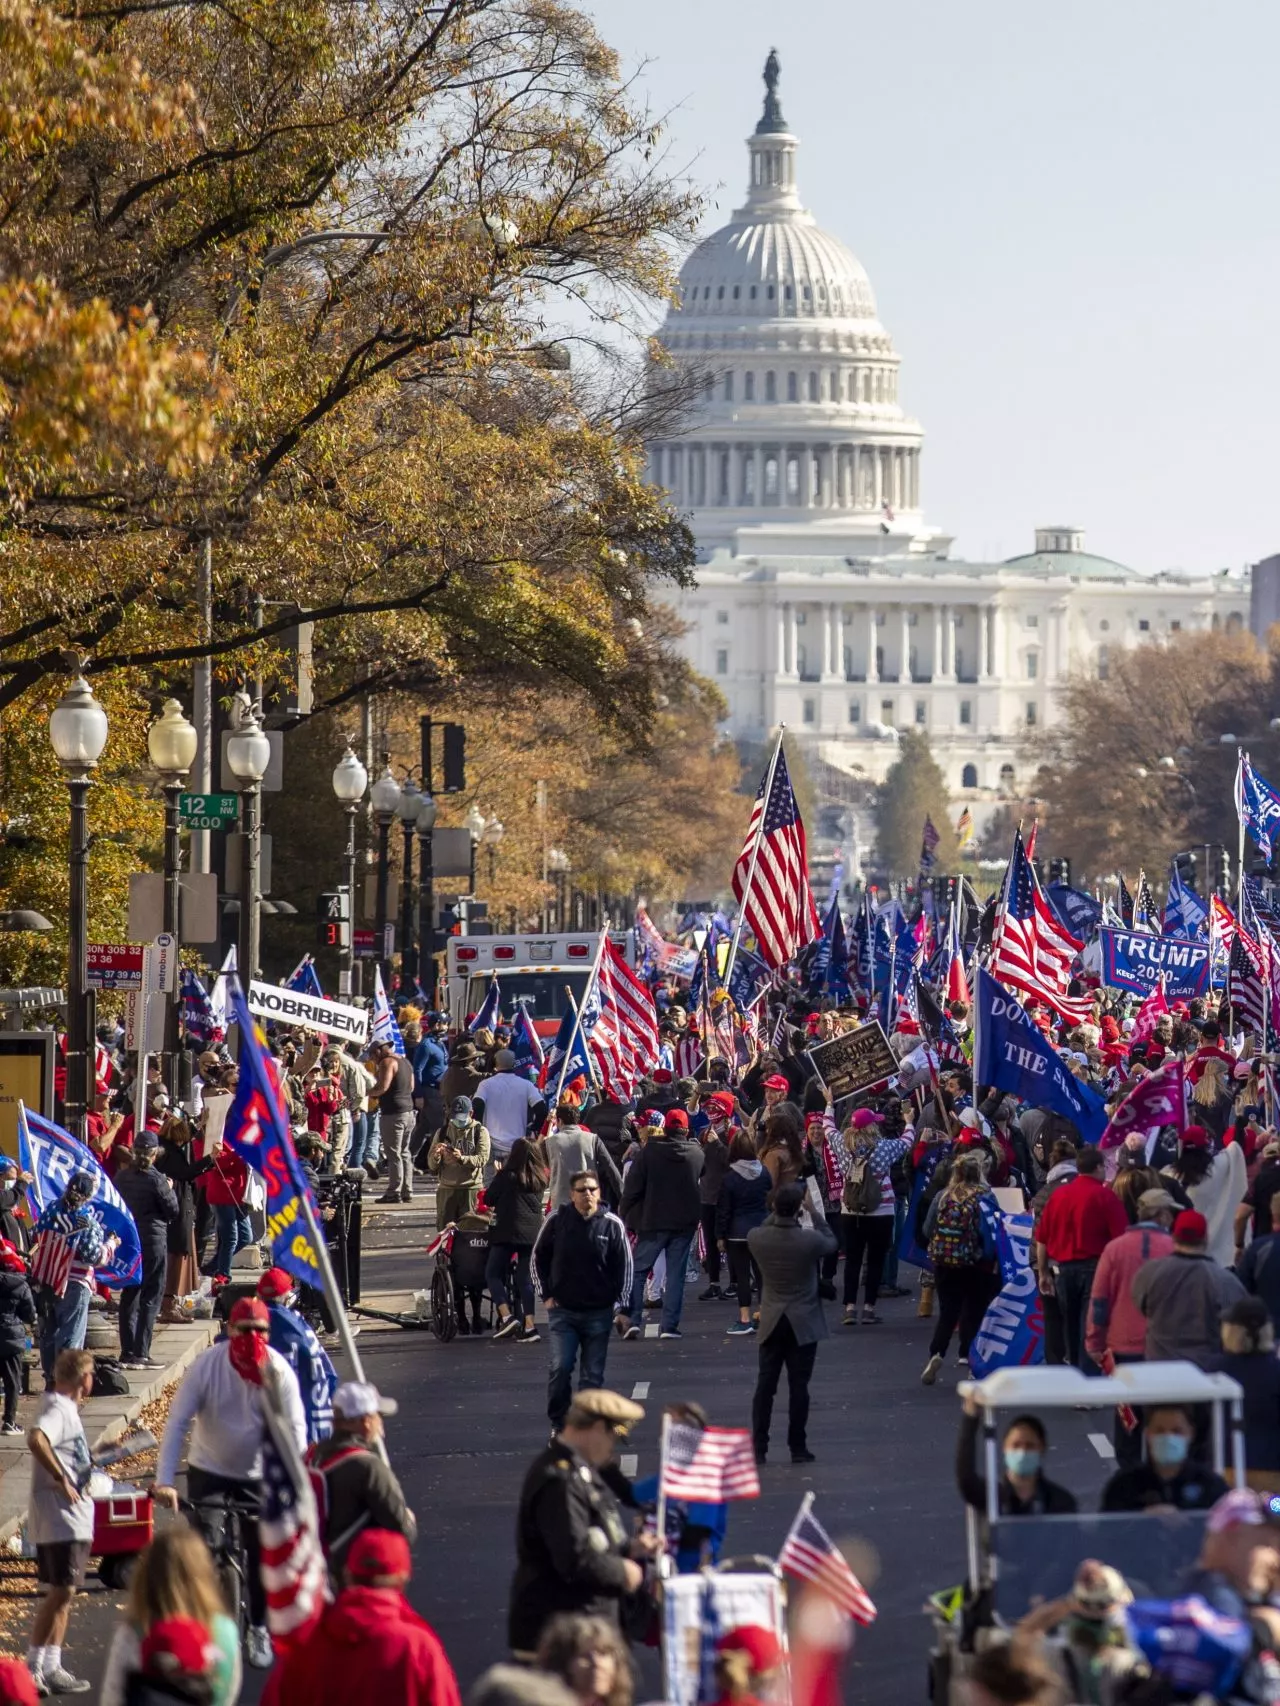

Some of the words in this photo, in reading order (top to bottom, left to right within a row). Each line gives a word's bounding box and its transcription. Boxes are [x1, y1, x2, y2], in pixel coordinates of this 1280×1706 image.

[183, 797, 206, 814] 12
[220, 798, 235, 807] ST
[220, 807, 234, 815] NW
[190, 816, 221, 829] 400
[327, 924, 336, 944] 3
[107, 946, 126, 954] 30S
[129, 947, 141, 955] 32
[1114, 933, 1207, 968] TRUMP
[117, 971, 128, 979] 39
[159, 948, 167, 990] metrobus
[249, 989, 365, 1036] NOBRIBEM
[127, 1020, 135, 1048] STOP
[1004, 1041, 1048, 1076] THE
[469, 1238, 489, 1248] driv
